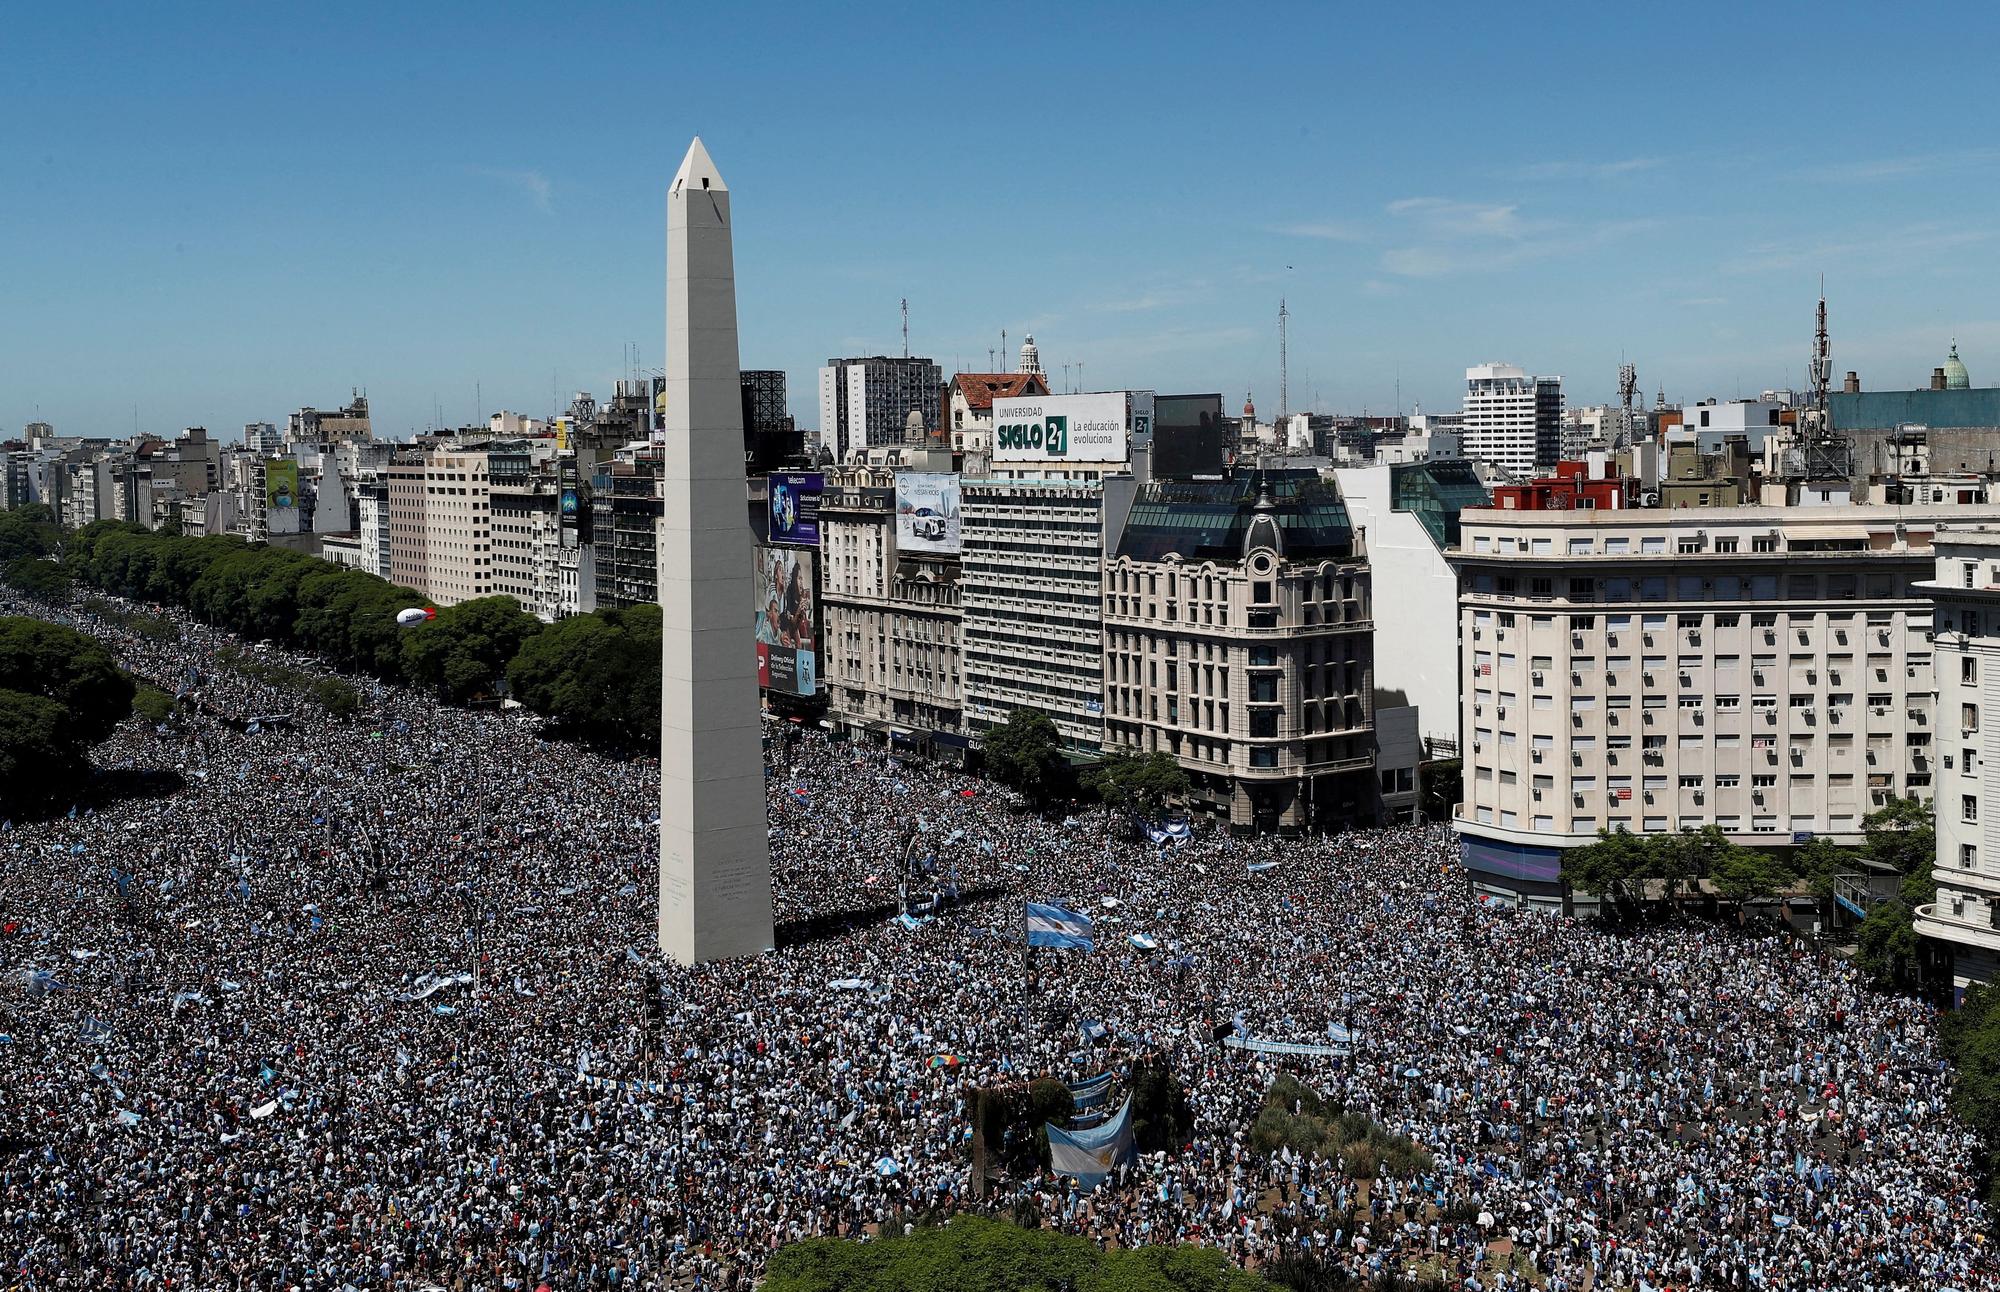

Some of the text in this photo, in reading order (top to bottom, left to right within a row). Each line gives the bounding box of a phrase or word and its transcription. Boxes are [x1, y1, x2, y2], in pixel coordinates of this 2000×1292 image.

[999, 407, 1043, 418] UNIVERSIDAD
[1073, 419, 1119, 432] La educación
[998, 422, 1064, 451] SIGLO 21
[1073, 433, 1112, 444] evoluciona
[788, 475, 806, 485] telecom
